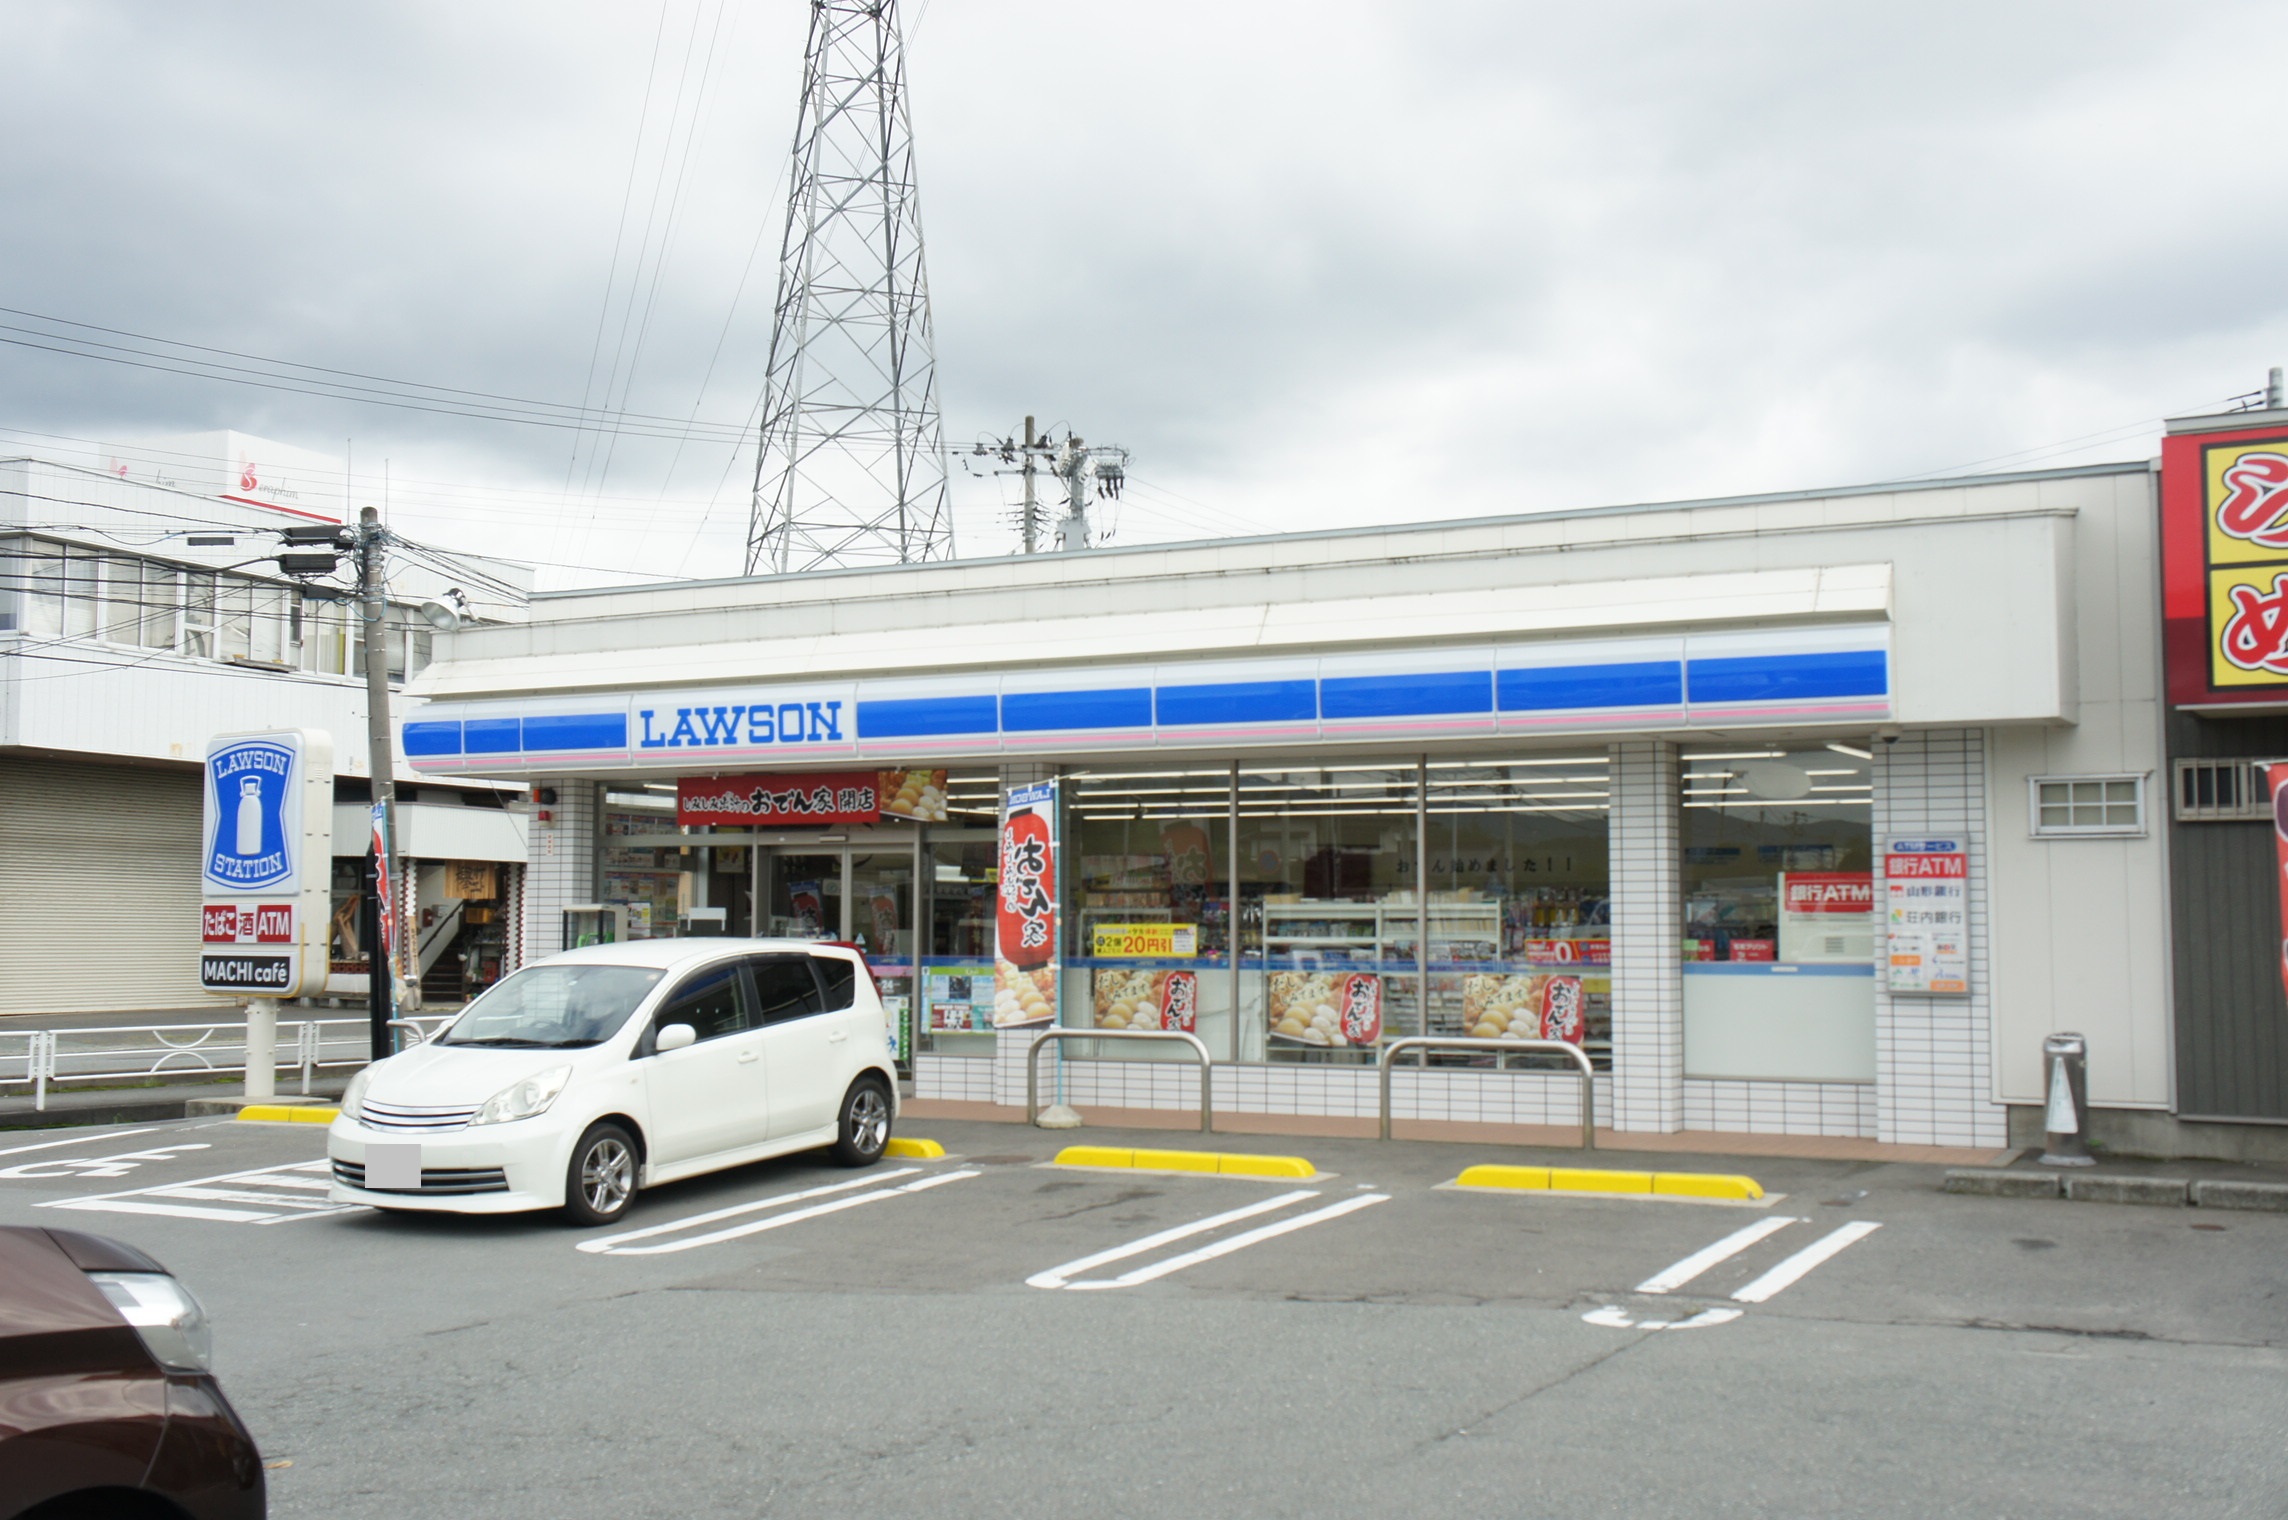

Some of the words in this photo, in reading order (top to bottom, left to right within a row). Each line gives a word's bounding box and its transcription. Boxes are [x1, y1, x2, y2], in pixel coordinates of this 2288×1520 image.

[640, 701, 842, 748] LAWSON
[216, 751, 287, 778] LAWSON
[215, 852, 283, 878] STATION
[1889, 857, 1962, 876] 銀行ATM
[1790, 884, 1871, 901] 銀行ATM
[204, 911, 236, 937] たばこ
[239, 912, 254, 936] 酒
[257, 911, 291, 936] ATM
[204, 961, 253, 982] MACHI
[254, 963, 287, 983] café
